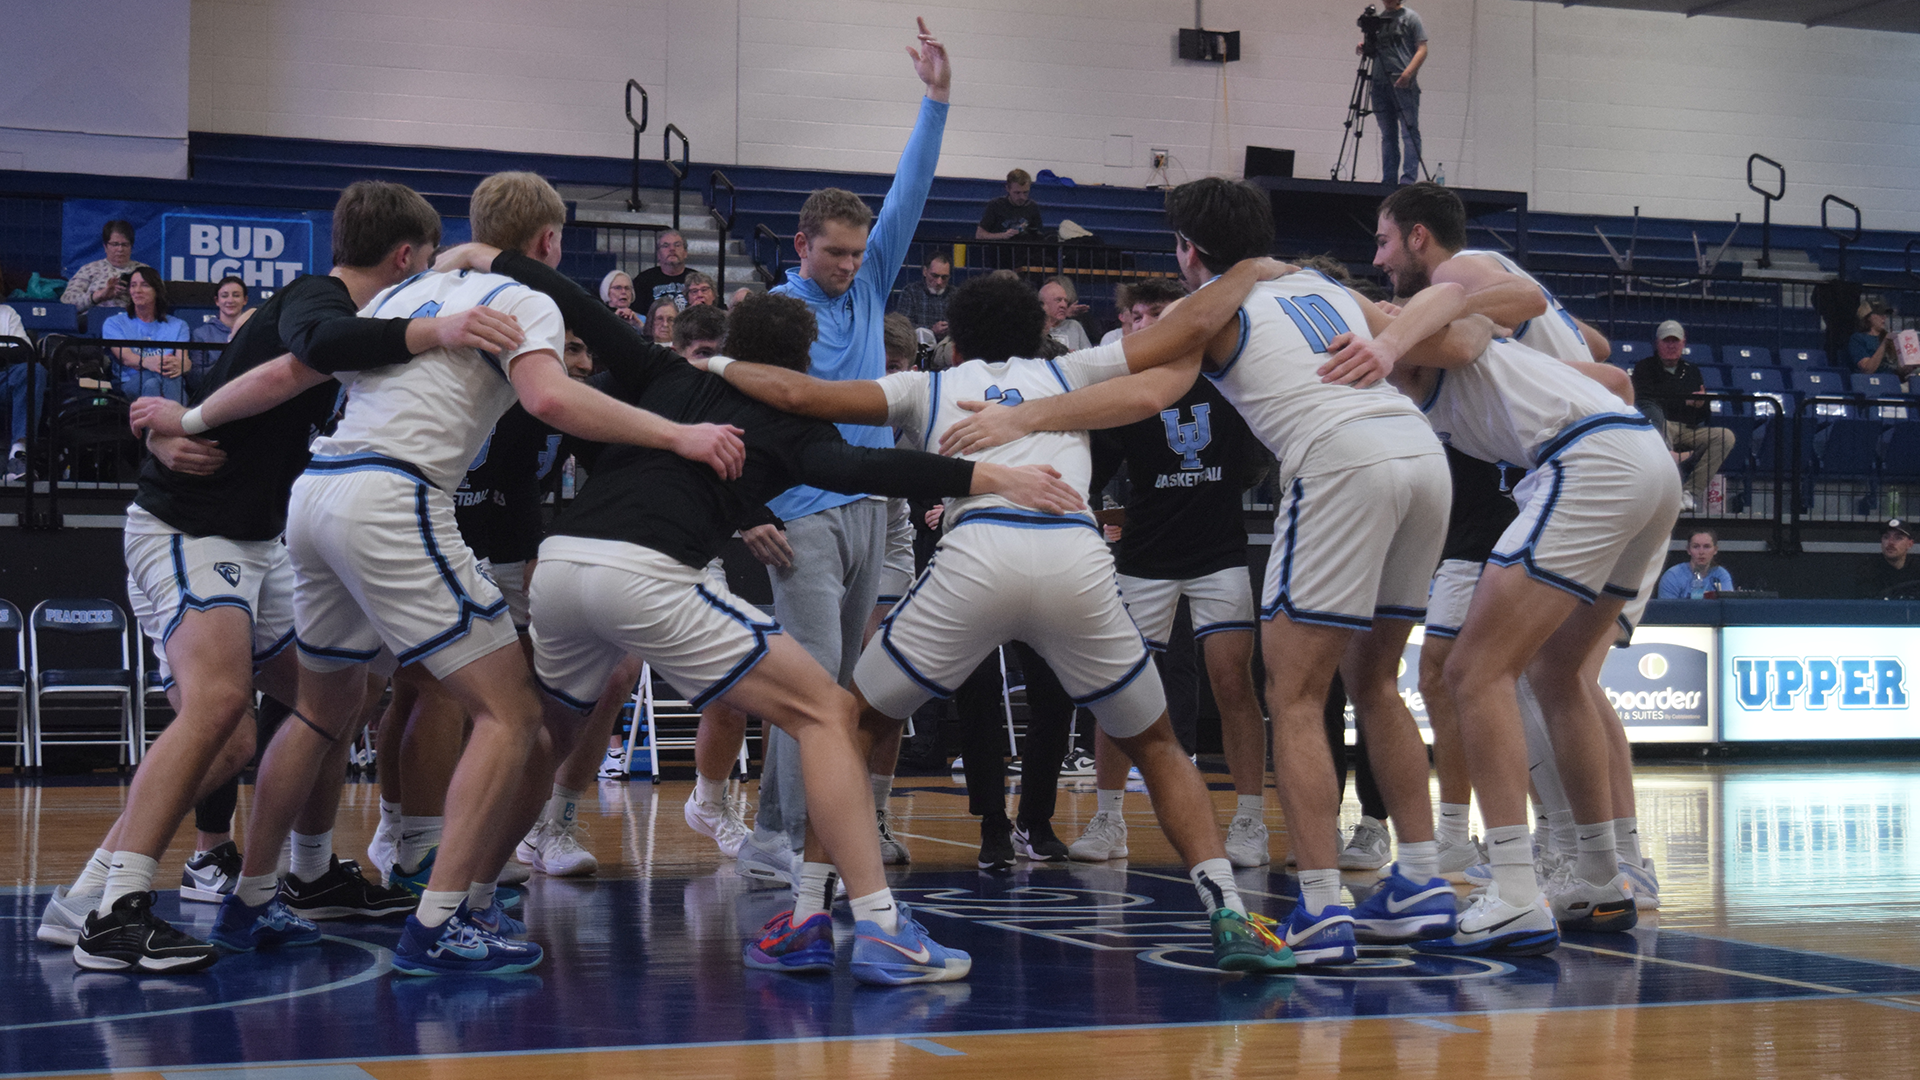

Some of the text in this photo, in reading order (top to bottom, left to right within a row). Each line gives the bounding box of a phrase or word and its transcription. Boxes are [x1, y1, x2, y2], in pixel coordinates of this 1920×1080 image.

[190, 224, 285, 259] BUD
[171, 256, 303, 287] LIGHT
[1273, 293, 1352, 355] 10
[45, 608, 113, 624] PEACOCKS
[1605, 686, 1701, 710] boarders
[1732, 656, 1910, 712] UPPER
[1623, 711, 1630, 720] &
[1632, 710, 1664, 720] SUITES
